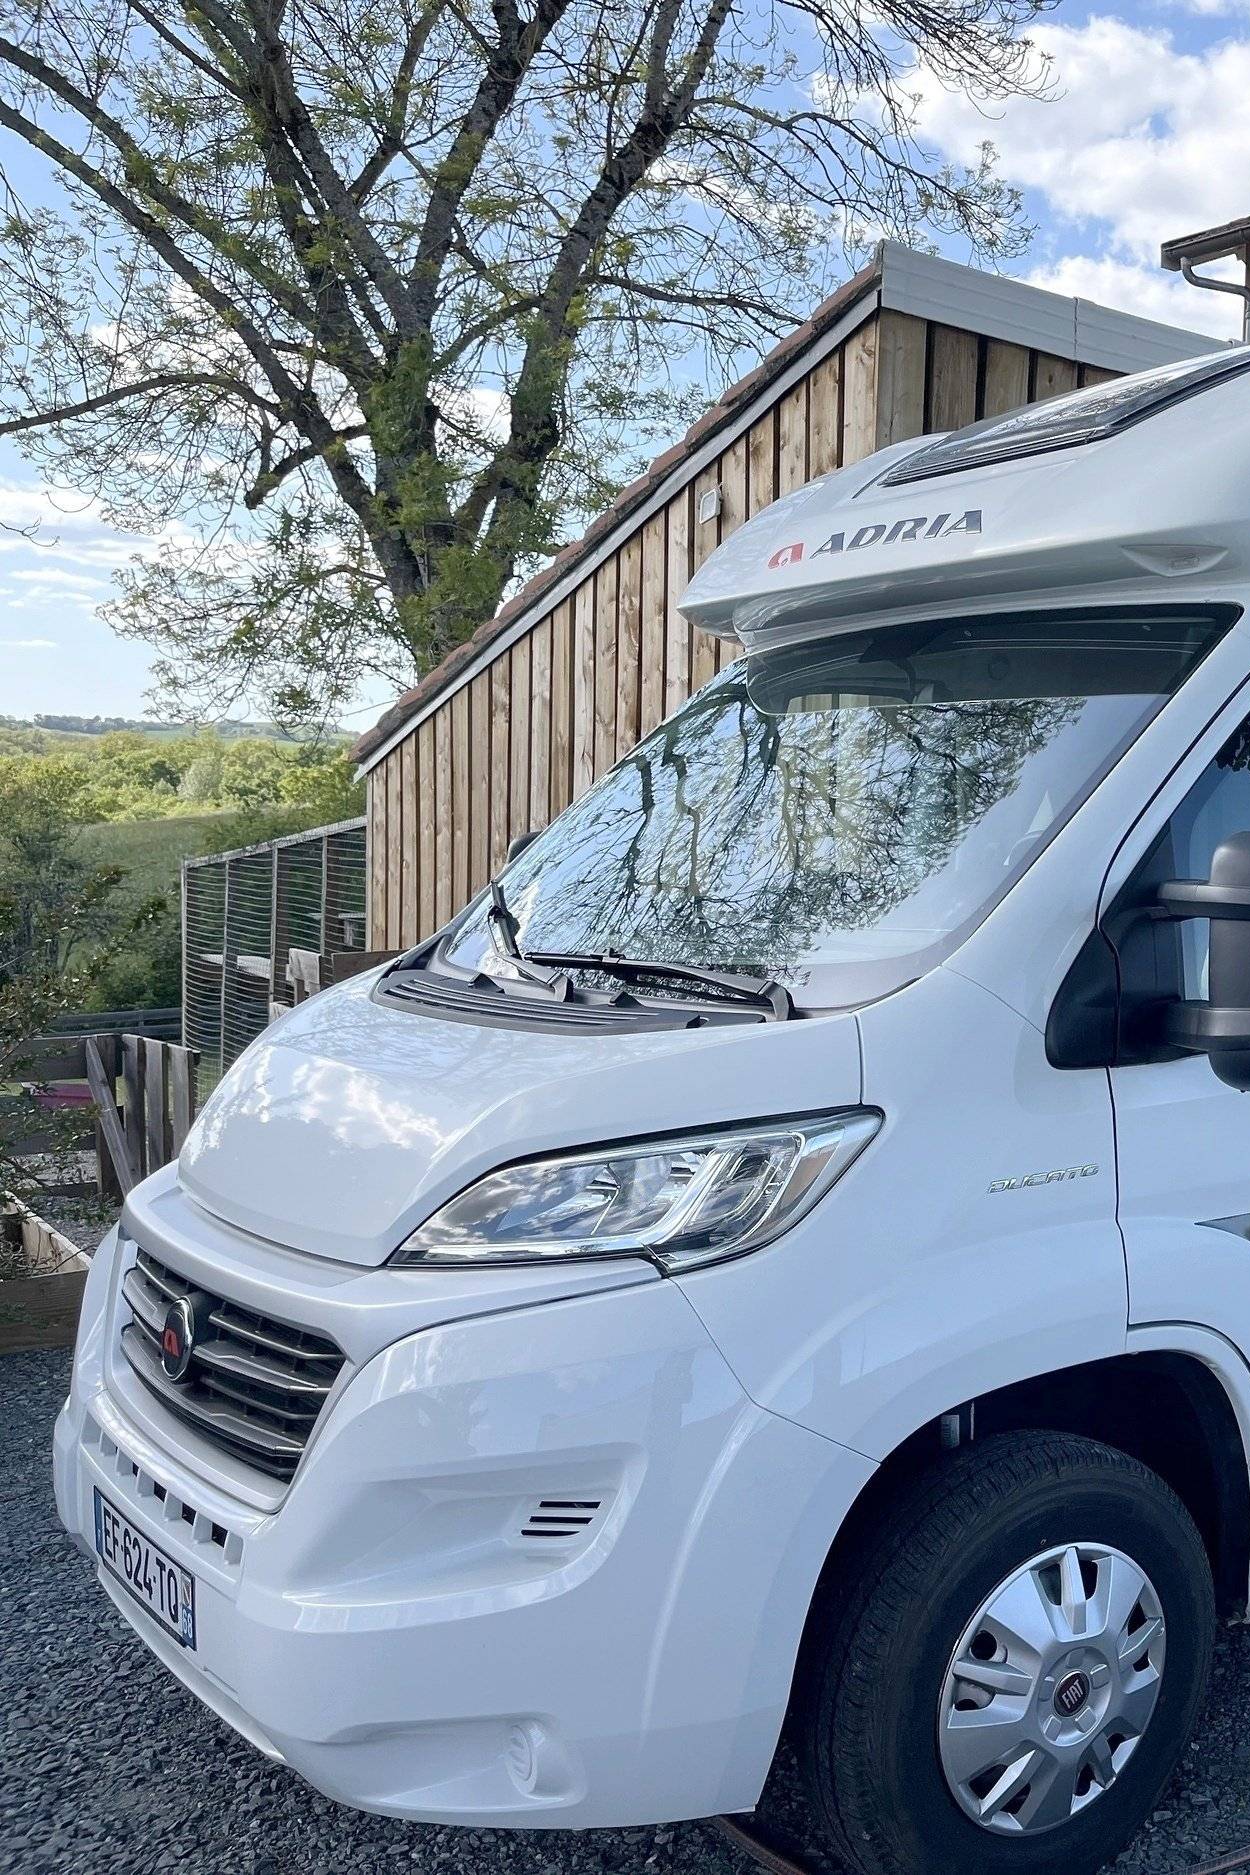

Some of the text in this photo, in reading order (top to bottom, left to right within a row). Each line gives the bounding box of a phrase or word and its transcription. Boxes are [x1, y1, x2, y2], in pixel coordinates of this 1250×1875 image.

[809, 509, 982, 560] ADRIA
[988, 1164, 1099, 1193] DUCATO
[1062, 1679, 1084, 1709] FIAT
